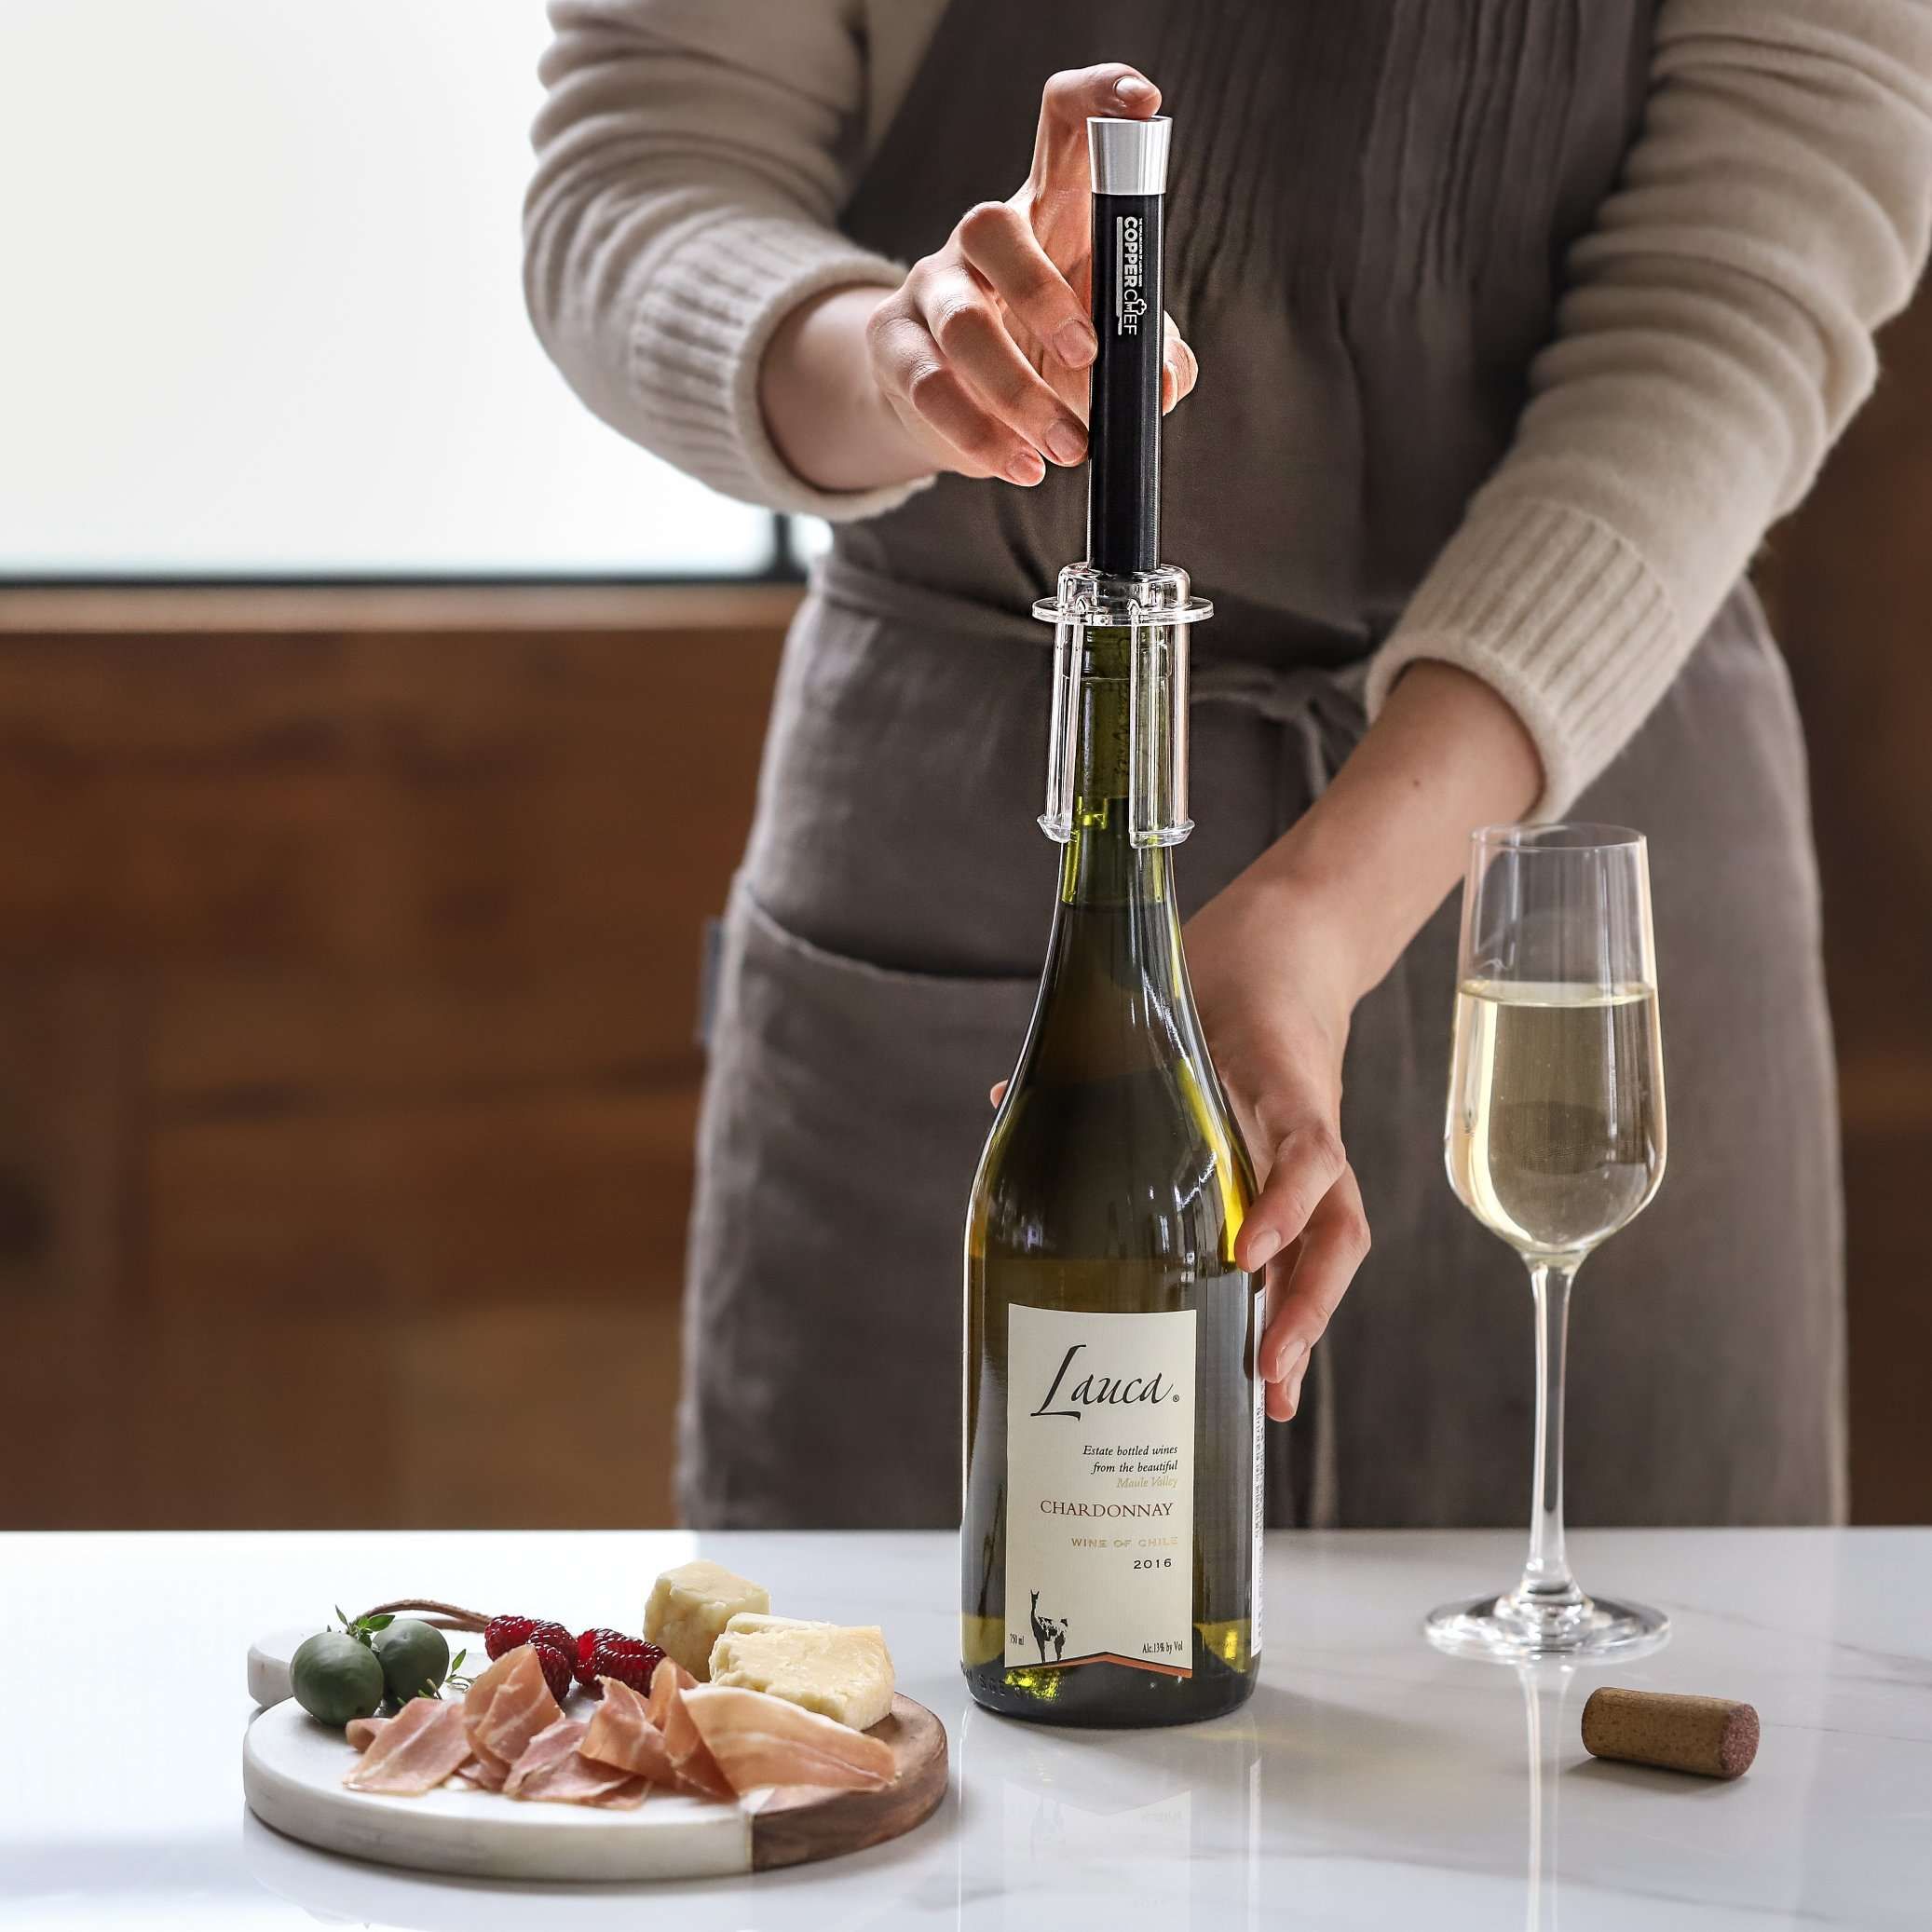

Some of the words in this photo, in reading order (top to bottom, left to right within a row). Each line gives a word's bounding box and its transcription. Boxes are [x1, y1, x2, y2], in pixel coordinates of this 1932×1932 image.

[1123, 216, 1138, 288] COPPER
[1123, 289, 1147, 335] CHEF
[1030, 1344, 1174, 1422] Lauca
[1082, 1445, 1113, 1455] Estate
[1117, 1445, 1149, 1455] bottled
[1152, 1445, 1177, 1455] wines
[1090, 1462, 1115, 1475] from
[1119, 1463, 1134, 1472] the
[1137, 1460, 1178, 1474] beautiful
[1116, 1477, 1148, 1488] Maule
[1151, 1476, 1178, 1489] Valley
[1041, 1500, 1174, 1517] CHARDONNAY
[1071, 1538, 1107, 1547] WINE
[1113, 1539, 1132, 1547] OF
[1137, 1537, 1178, 1547] CHILE
[1133, 1558, 1172, 1569] 2016
[1165, 1641, 1173, 1654] by
[1174, 1640, 1183, 1652] Vol
